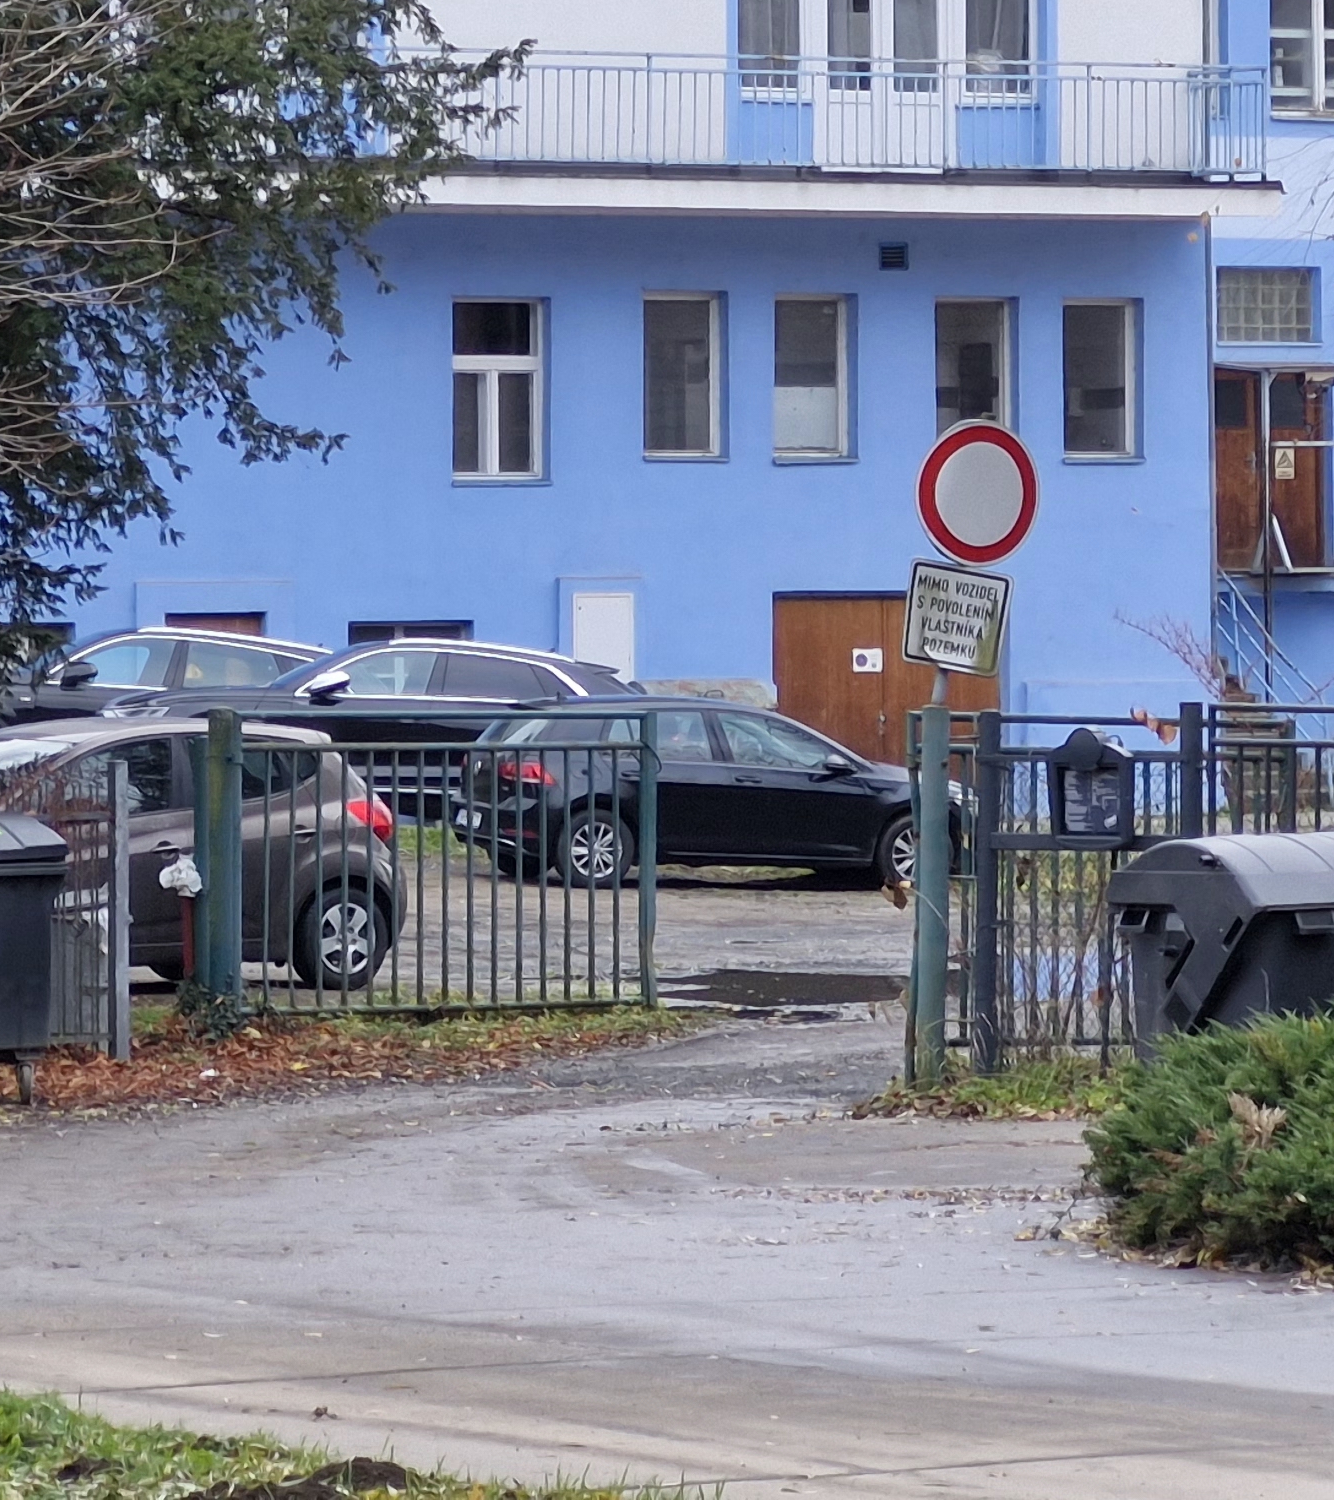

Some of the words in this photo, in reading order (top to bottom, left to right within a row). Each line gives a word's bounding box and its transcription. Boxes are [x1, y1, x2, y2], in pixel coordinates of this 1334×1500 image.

[917, 574, 949, 593] MIMO
[955, 581, 999, 603] VOZIDEL
[917, 595, 925, 609] S
[921, 616, 984, 641] VLASTNÍKA
[922, 637, 976, 659] POZEMKU
